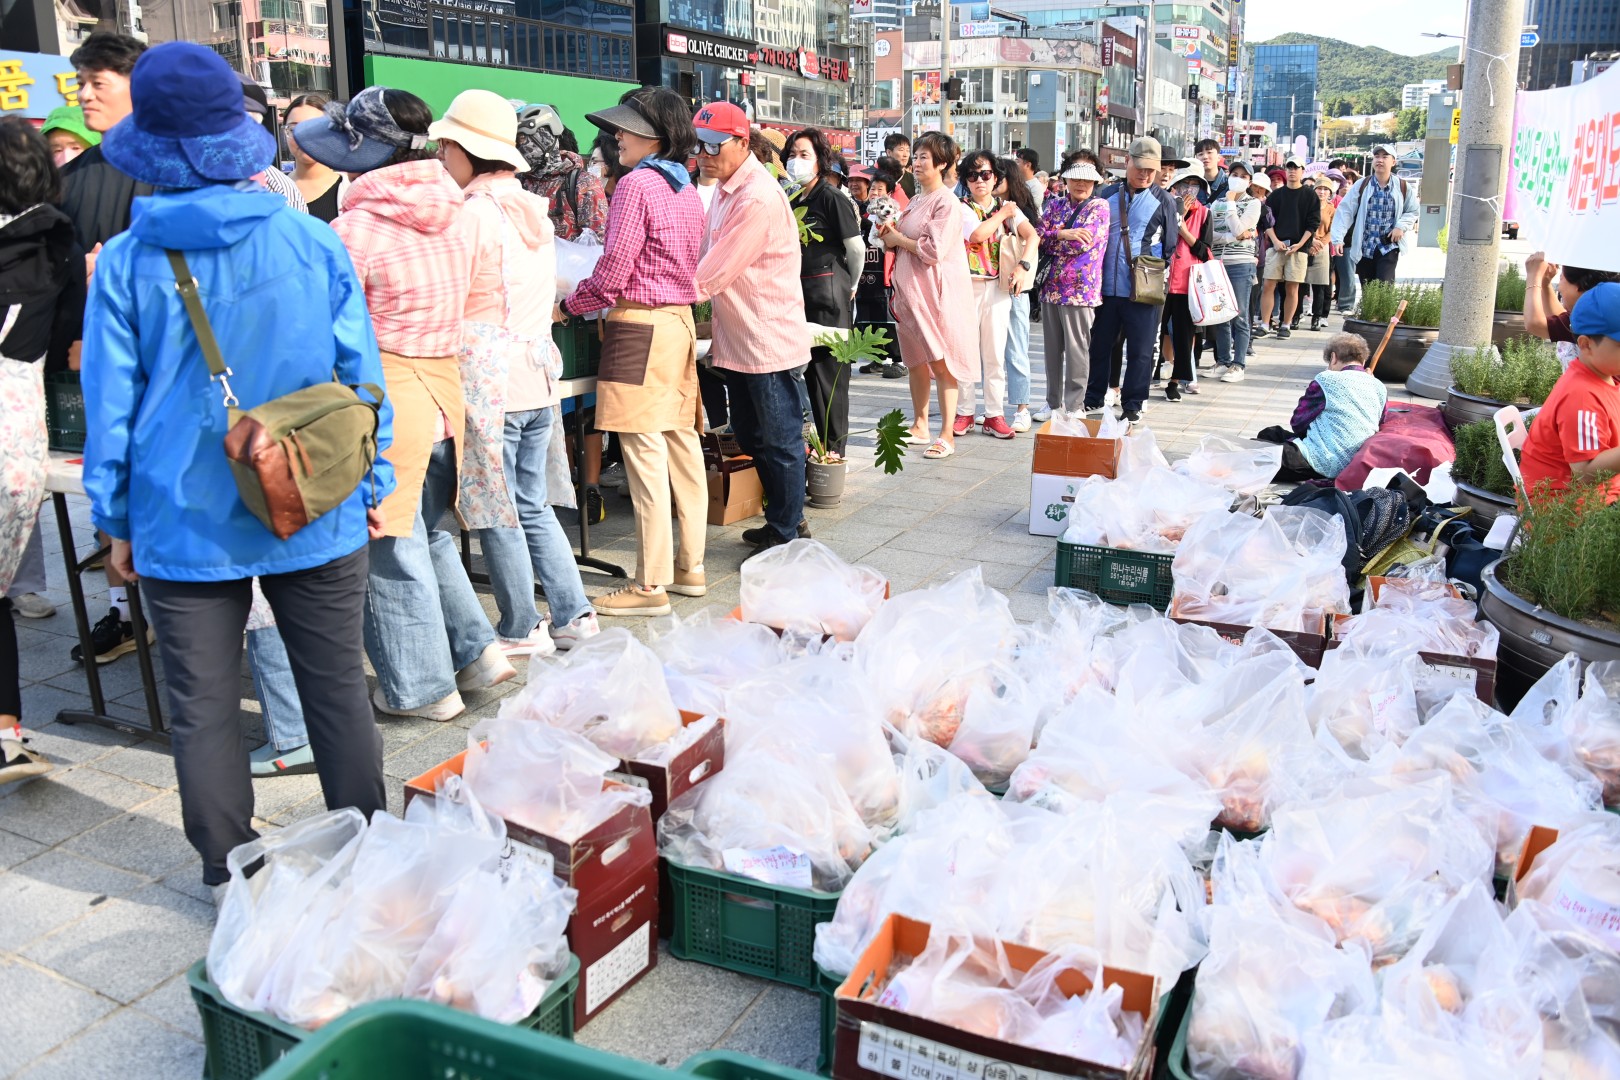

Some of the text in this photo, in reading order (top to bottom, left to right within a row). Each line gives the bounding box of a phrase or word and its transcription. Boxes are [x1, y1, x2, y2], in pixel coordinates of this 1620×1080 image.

[671, 37, 686, 51] bbq
[688, 39, 714, 56] OLIVE
[714, 44, 749, 62] CHICKEN
[699, 109, 714, 124] NY
[1568, 112, 1620, 211] 해운대도
